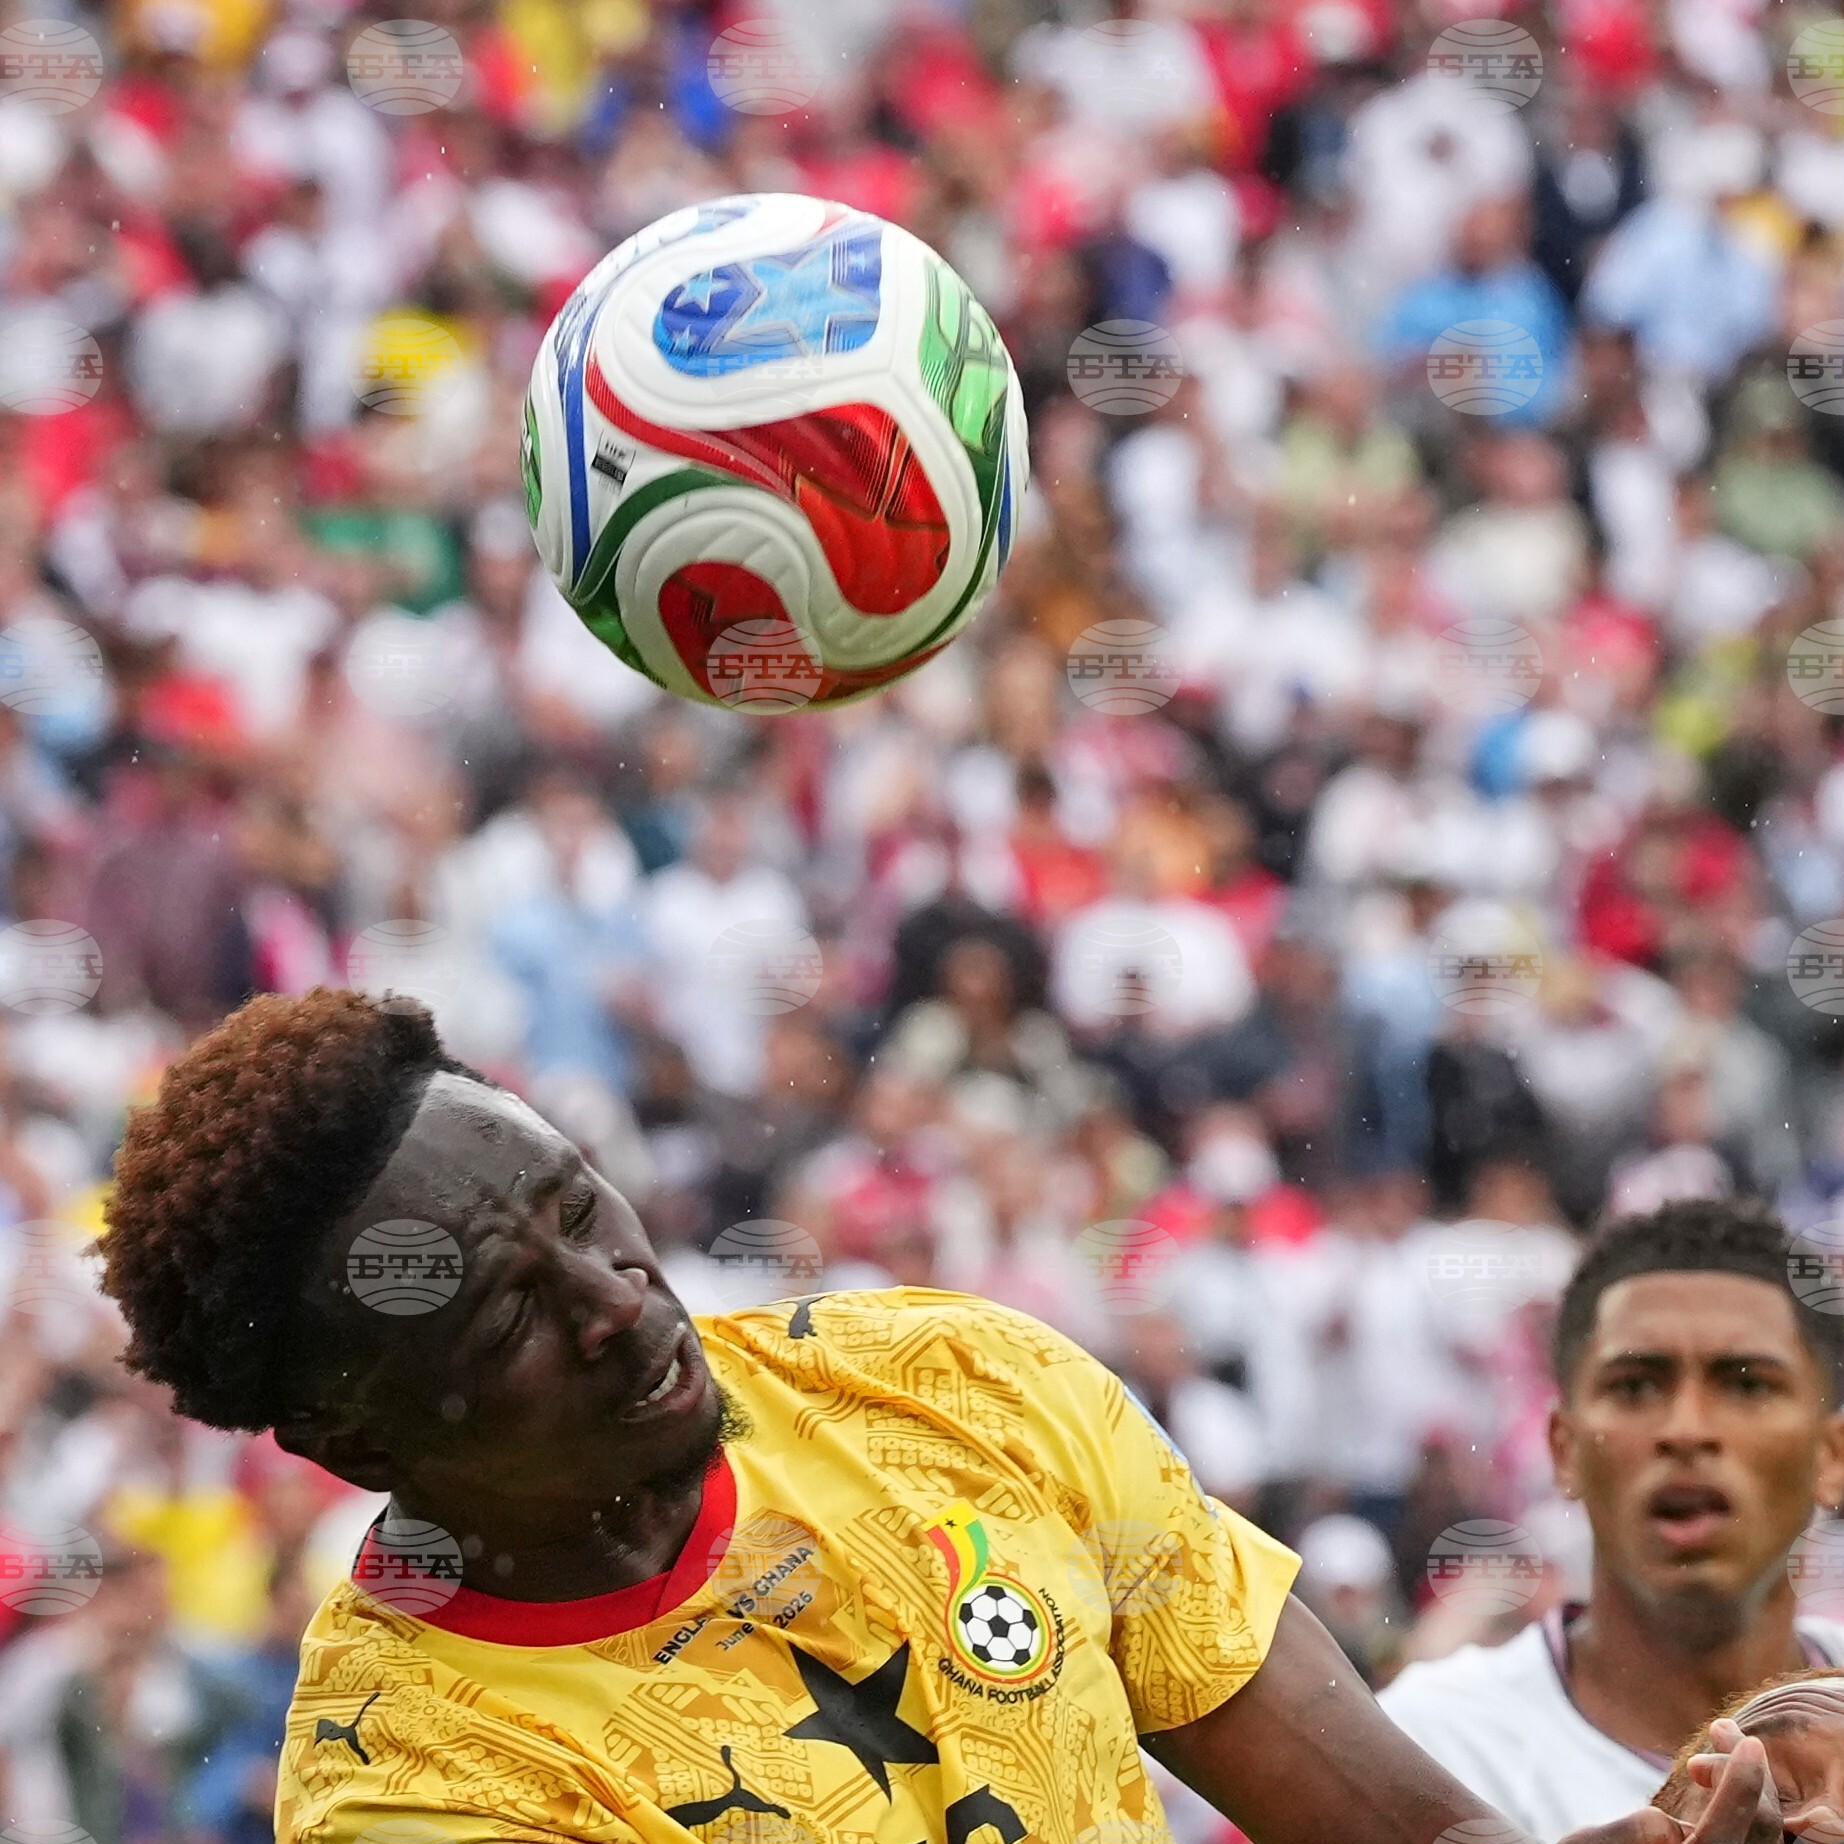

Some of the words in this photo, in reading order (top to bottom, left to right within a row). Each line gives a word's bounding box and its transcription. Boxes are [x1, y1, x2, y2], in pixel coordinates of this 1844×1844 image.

[726, 1593, 756, 1619] VS
[753, 1546, 813, 1597] GHANA
[715, 1622, 754, 1651] June
[773, 1591, 813, 1629] 2026
[938, 1657, 984, 1698] GHANA
[987, 1677, 1056, 1704] FOOTBALL
